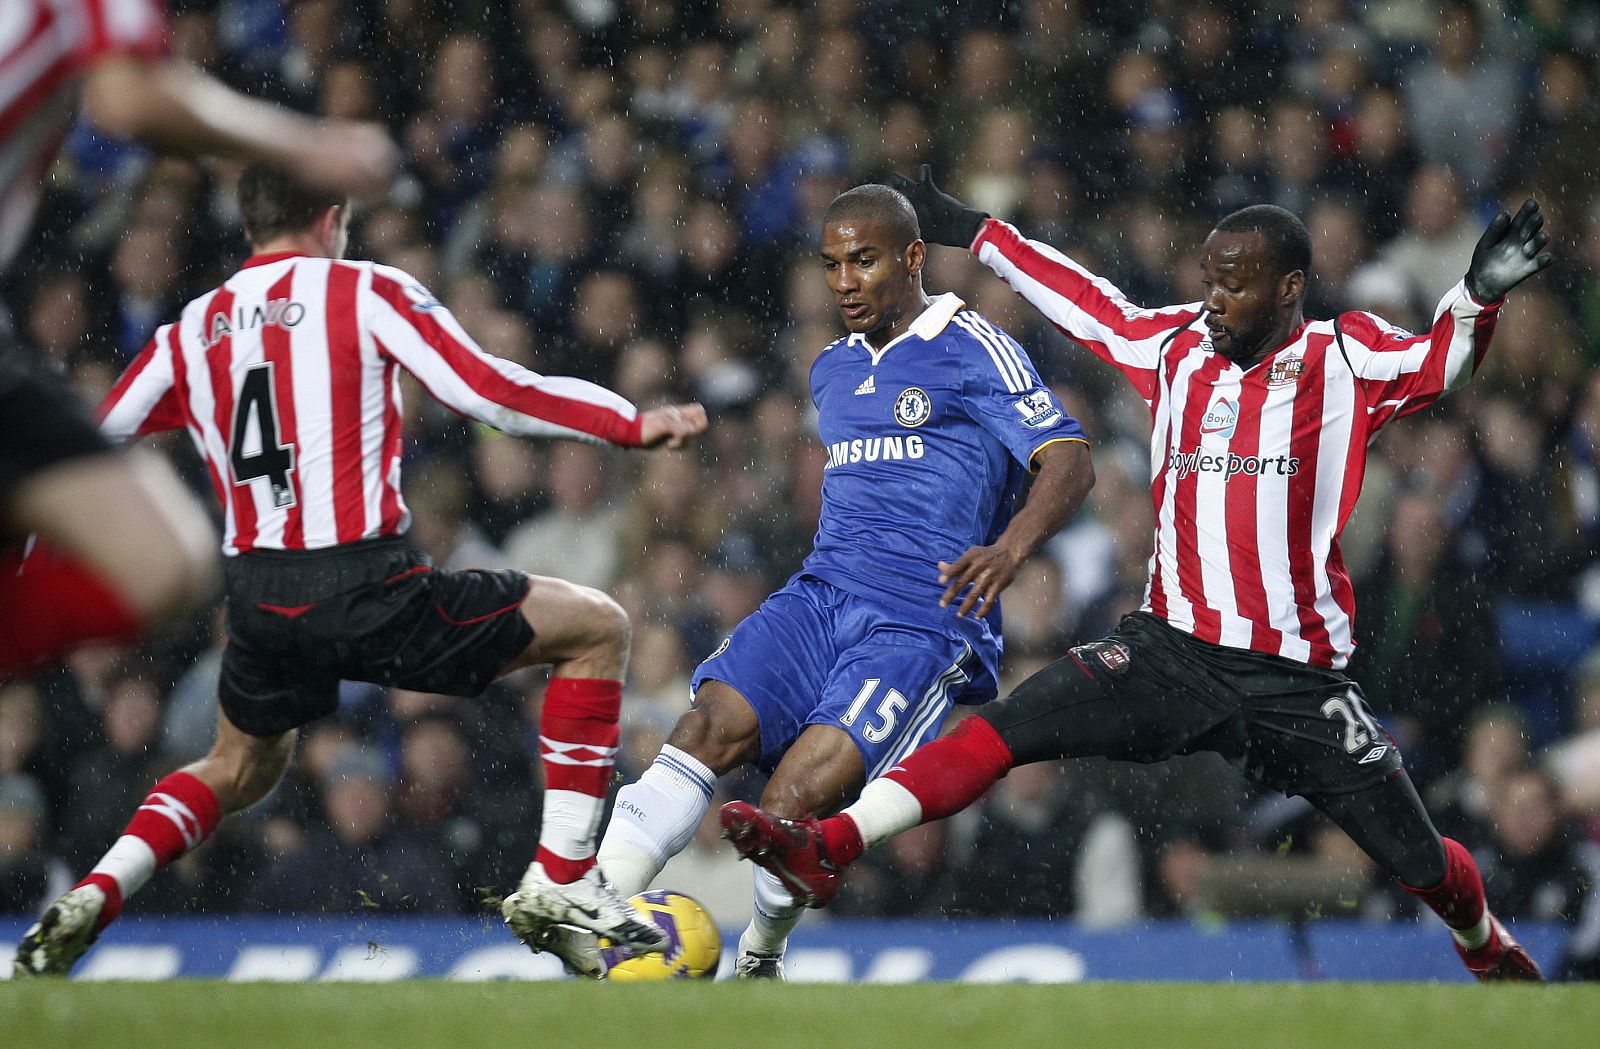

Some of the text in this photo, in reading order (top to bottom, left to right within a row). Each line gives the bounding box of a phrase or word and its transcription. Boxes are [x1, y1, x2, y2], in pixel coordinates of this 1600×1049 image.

[228, 361, 297, 510] 4
[1206, 412, 1236, 425] Boyle
[824, 436, 924, 469] AMSUNG
[840, 679, 909, 743] 15
